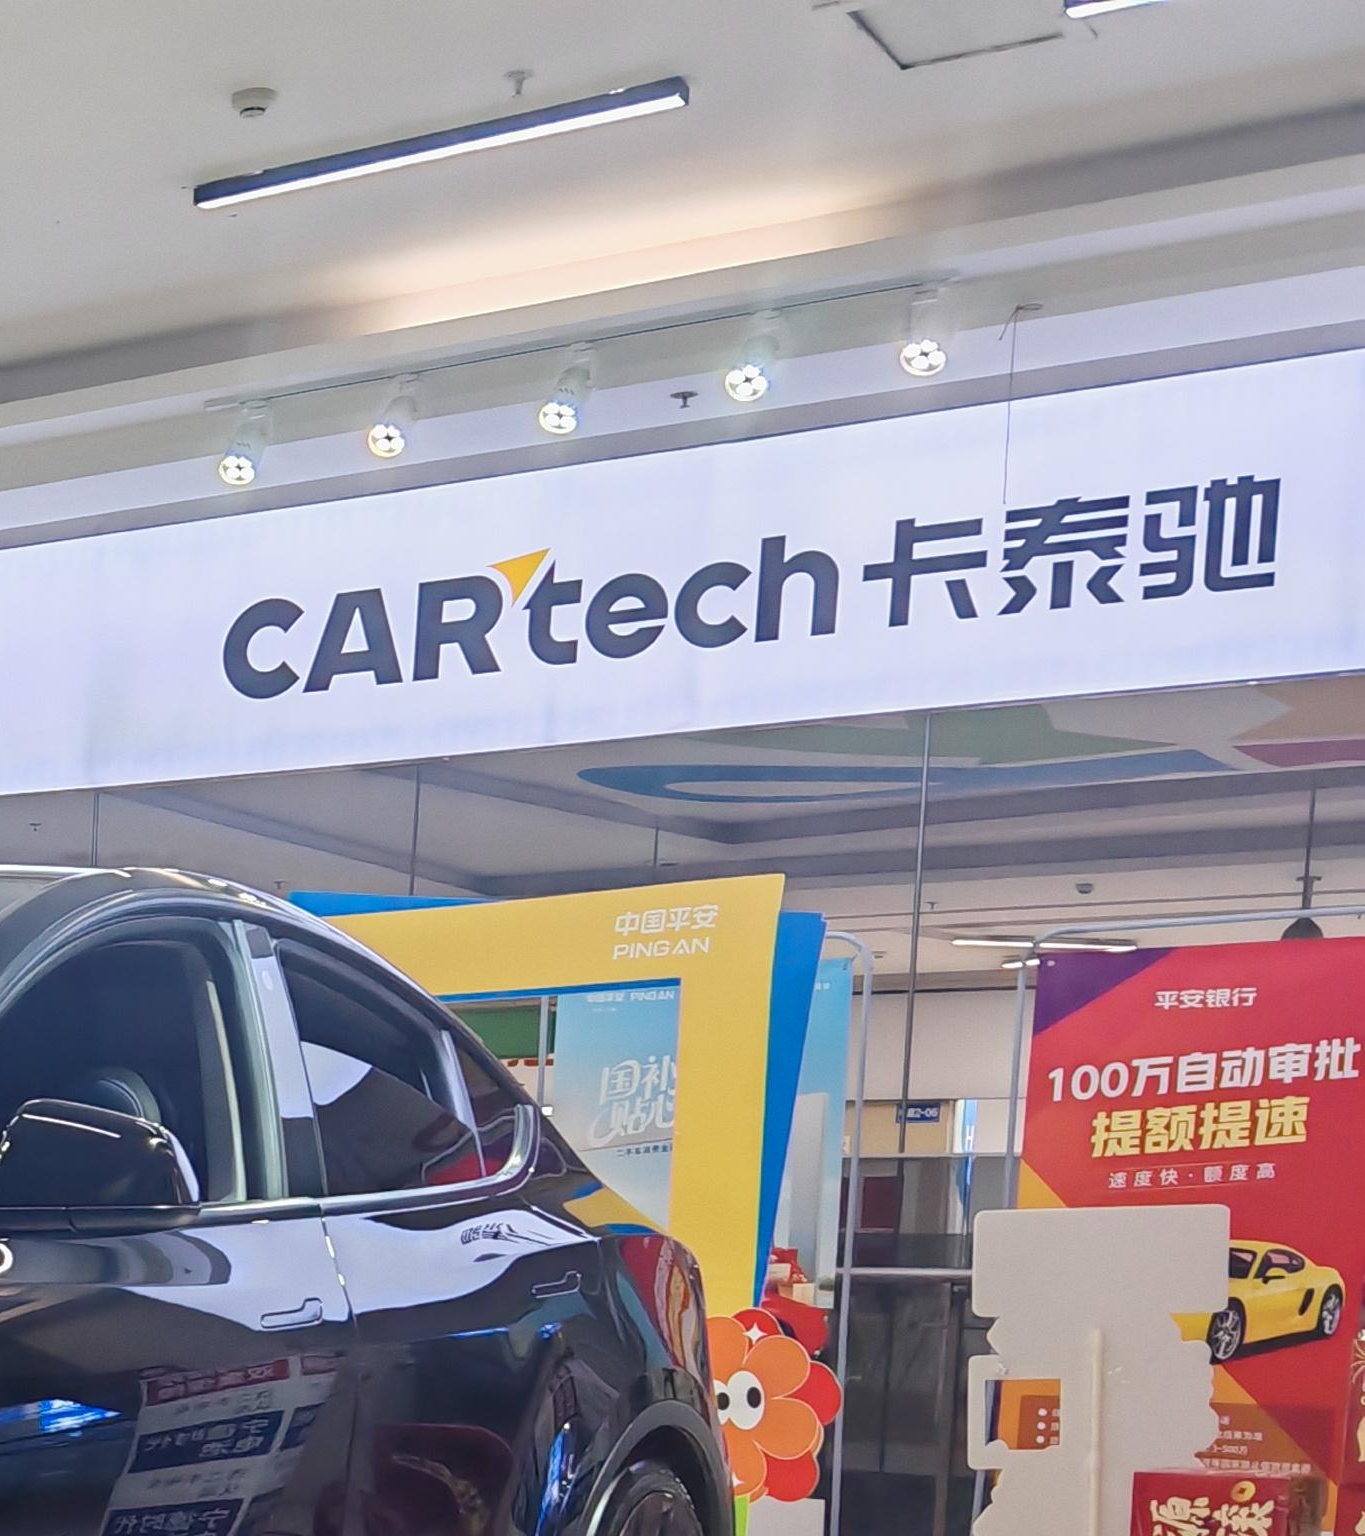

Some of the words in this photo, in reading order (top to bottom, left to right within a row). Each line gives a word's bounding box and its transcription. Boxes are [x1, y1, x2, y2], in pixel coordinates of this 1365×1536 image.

[223, 536, 836, 699] CARtech
[863, 475, 1281, 628] 卡泰驰
[614, 904, 719, 937] 中国平安
[1154, 986, 1257, 1010] 平安银行
[1048, 1036, 1361, 1103] 100万自动审批
[1091, 1095, 1310, 1159] 提额提速
